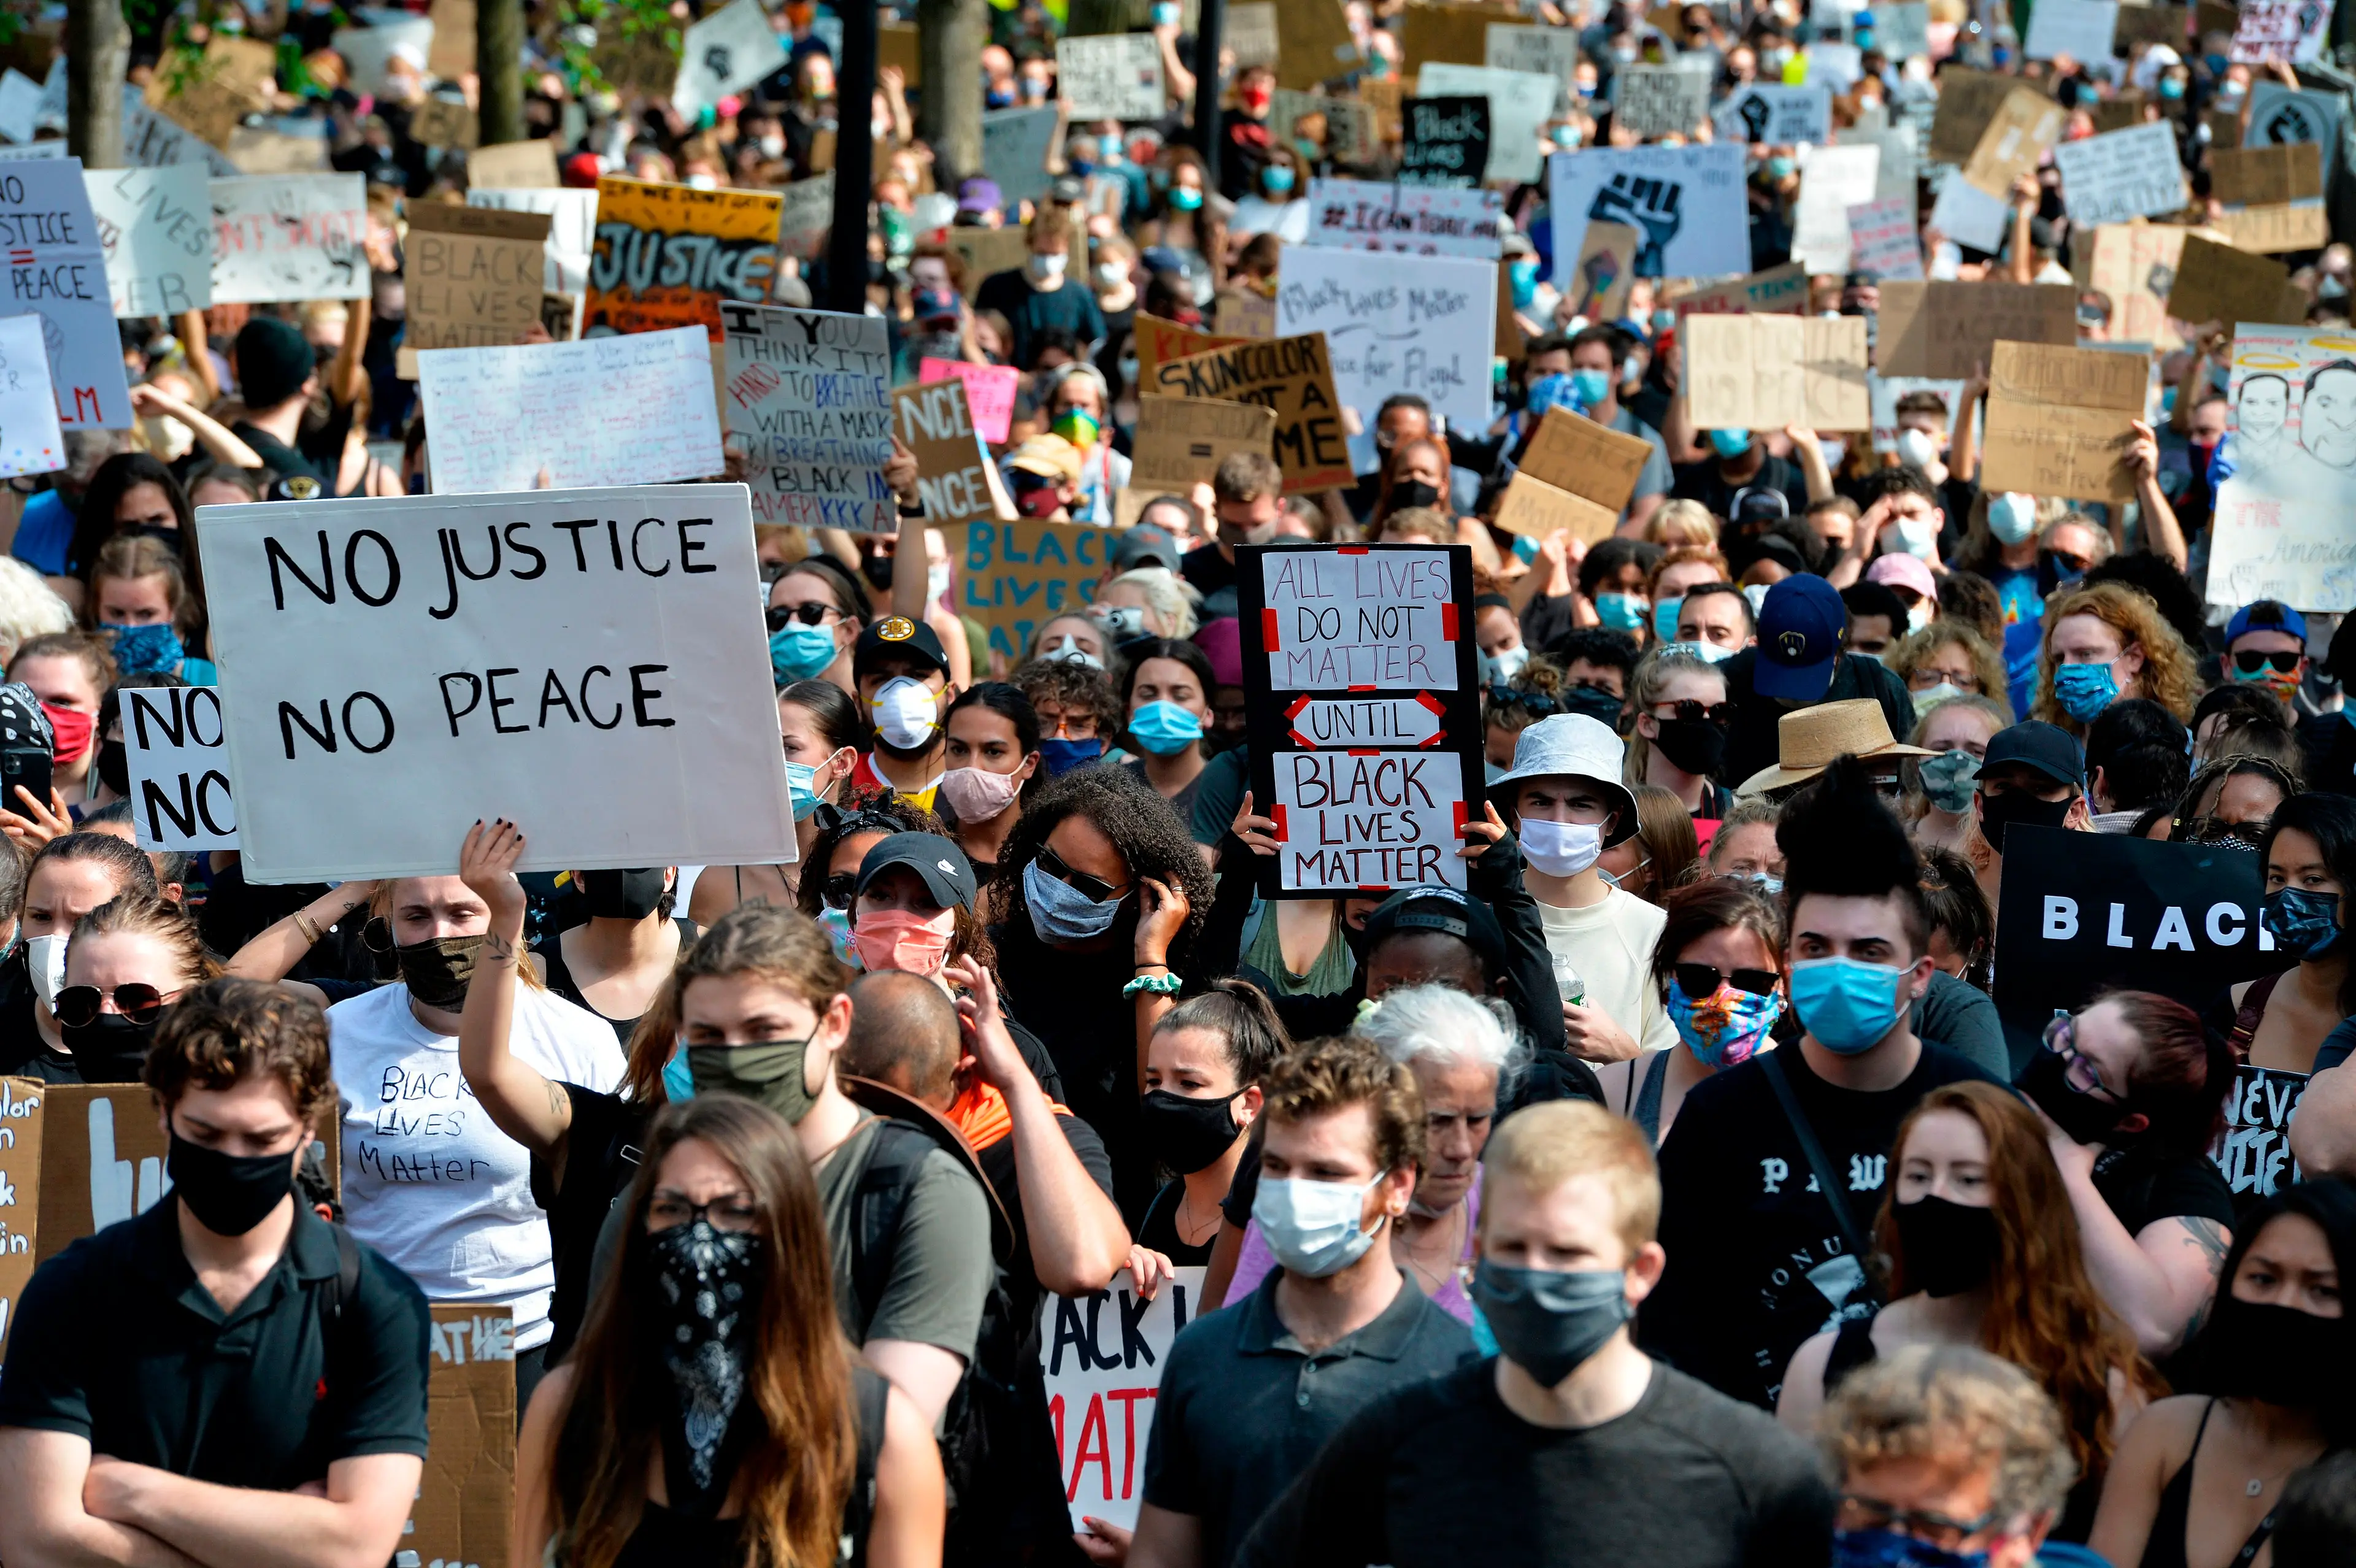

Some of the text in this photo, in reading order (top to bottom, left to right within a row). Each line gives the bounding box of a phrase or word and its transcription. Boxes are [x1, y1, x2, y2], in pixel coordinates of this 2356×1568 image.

[114, 167, 211, 258] LIVES
[12, 264, 93, 301] PEACE
[420, 237, 539, 287] BLACK
[592, 222, 777, 302] JUSTICE
[125, 272, 194, 312] ER
[415, 283, 536, 323] LIVES
[722, 306, 784, 336] IF
[793, 313, 863, 347] YOU
[727, 335, 823, 368] THINK
[726, 362, 781, 410] HARD
[781, 370, 815, 402] TO
[814, 372, 891, 410] BREATHE
[1299, 381, 1329, 410] A
[750, 407, 890, 440] WITH A MASK
[774, 435, 893, 467] BREATHING
[771, 465, 890, 501] BLACK IN
[264, 517, 718, 621] NO JUSTICE
[1272, 556, 1450, 601] ALL LIVES
[1298, 605, 1425, 643] DO NOT
[1287, 644, 1436, 686] MATTER
[129, 686, 224, 752] NO
[277, 663, 676, 760] NO PEACE
[1311, 701, 1415, 741] UNTIL
[1293, 754, 1436, 810] BLACK
[141, 768, 236, 844] NO
[1319, 809, 1422, 846] LIVES
[1295, 843, 1451, 887] MATTER
[0, 1080, 40, 1121] lor
[380, 1065, 475, 1104] BLACK
[375, 1107, 466, 1137] LIVES
[1040, 1288, 1157, 1377] ACK
